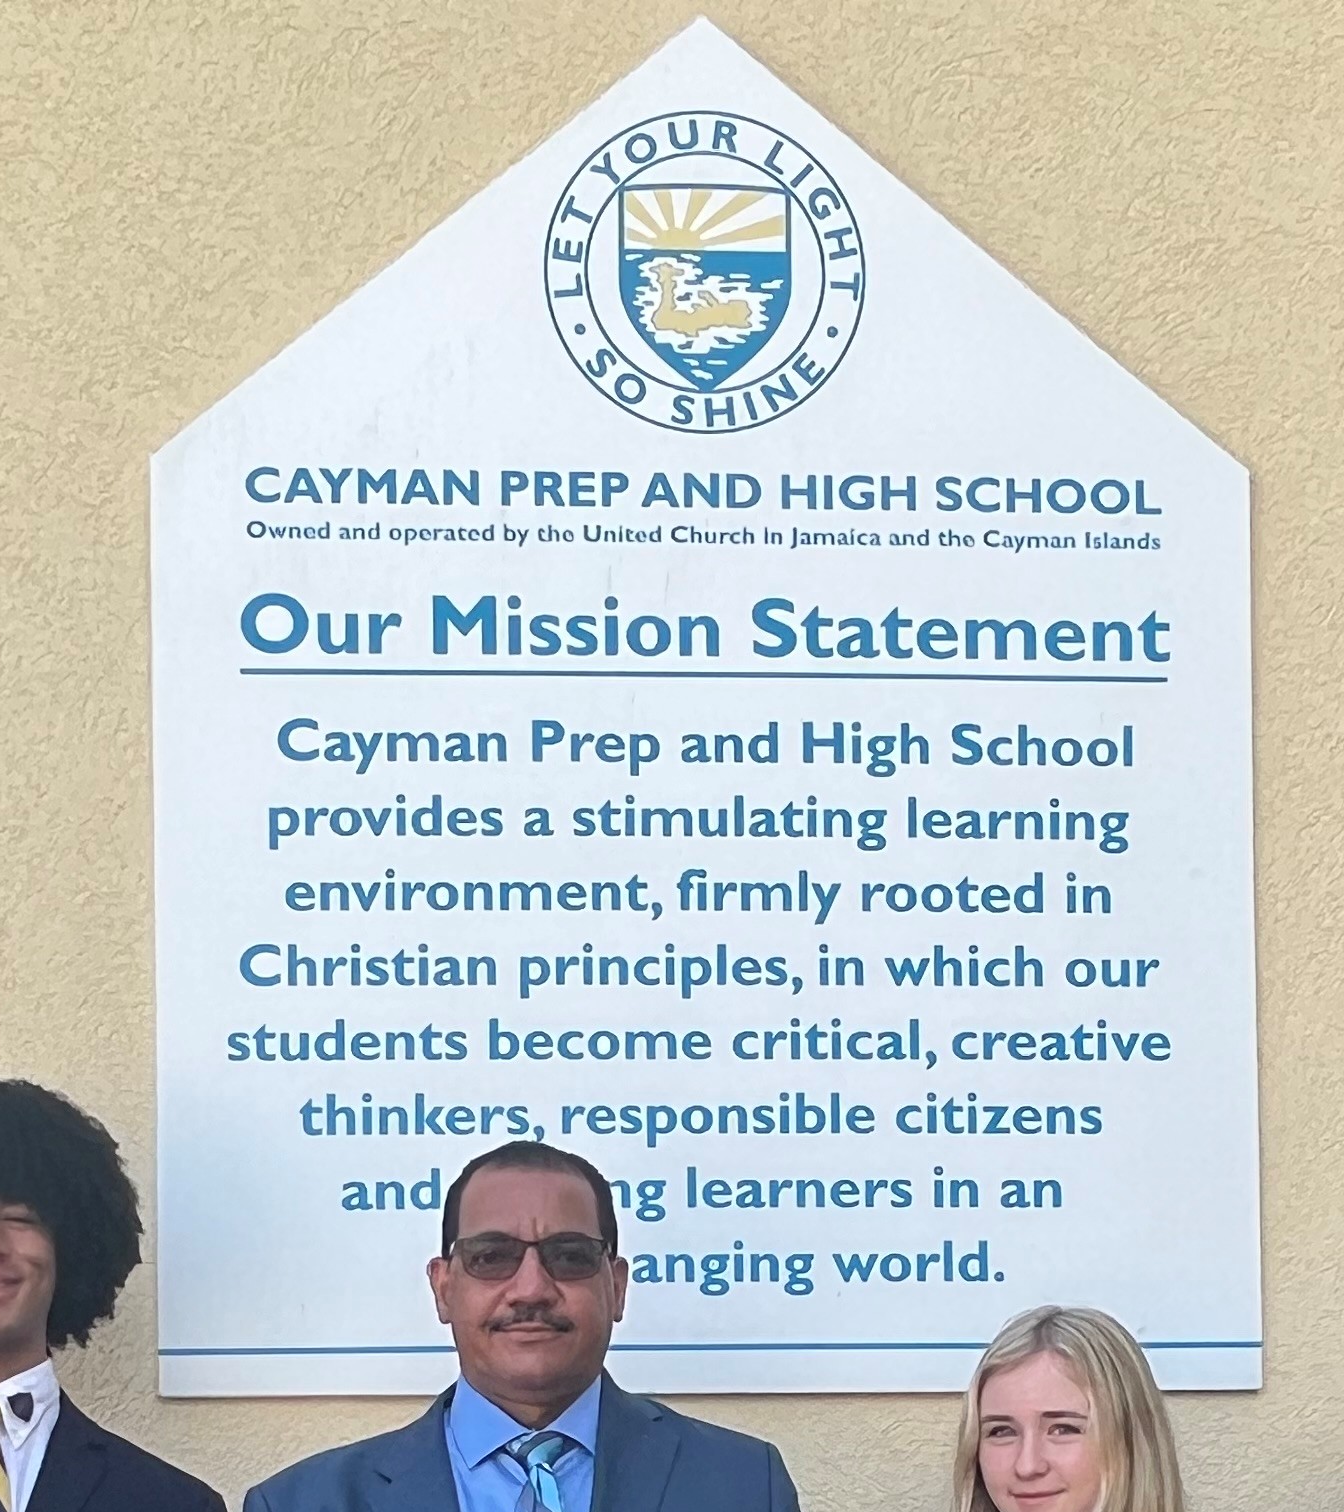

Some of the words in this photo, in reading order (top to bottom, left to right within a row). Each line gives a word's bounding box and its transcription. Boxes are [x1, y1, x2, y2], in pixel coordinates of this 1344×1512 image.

[552, 195, 594, 299] LET
[590, 119, 738, 185] YOUR
[763, 140, 861, 302] LIGHT
[585, 348, 647, 405] SO
[671, 352, 826, 428] SHINE
[245, 466, 480, 506] CAYMAN
[501, 470, 629, 508] PREP
[642, 472, 762, 509] AND
[781, 474, 916, 512] HIGH
[936, 476, 1162, 516] SCHOOL
[246, 521, 330, 539] Owned
[339, 522, 380, 540] and
[389, 524, 494, 546] operated
[503, 523, 529, 547] by
[538, 524, 574, 542] the
[583, 525, 662, 543] United
[671, 525, 755, 544] Church
[790, 527, 881, 549] Jamaica
[889, 529, 930, 546] and
[938, 529, 975, 547] the
[983, 530, 1076, 553] Cayman
[1085, 532, 1162, 550] Islands
[240, 592, 402, 655] Our
[432, 595, 720, 658] Mission
[752, 597, 1171, 663] Statement
[277, 718, 507, 775] Cayman
[531, 719, 660, 777] Prep
[681, 721, 779, 764] and
[802, 721, 929, 778] High
[951, 721, 1134, 768] School
[268, 794, 503, 850] provides
[524, 807, 552, 837] a
[573, 794, 887, 852] stimulating
[908, 796, 1130, 854] learning
[285, 872, 663, 921] environment,
[676, 868, 842, 925] firmly
[861, 871, 1044, 914] rooted
[1066, 871, 1112, 915] in
[239, 943, 496, 987] Christian
[520, 943, 804, 1000] principles,
[819, 943, 864, 987] in
[884, 944, 1043, 988] which
[1065, 959, 1160, 988] our
[227, 1018, 468, 1062] students
[488, 1017, 711, 1061] become
[732, 1018, 938, 1070] critical,
[952, 1019, 1171, 1062] creative
[299, 1092, 545, 1142] thinkers,
[560, 1091, 875, 1144] responsible
[896, 1092, 1103, 1136] citizens
[340, 1167, 441, 1213] and
[685, 1166, 913, 1210] learners
[933, 1166, 980, 1209] in
[999, 1179, 1063, 1209] an
[631, 1240, 815, 1297] anging
[831, 1240, 1005, 1284] world.
